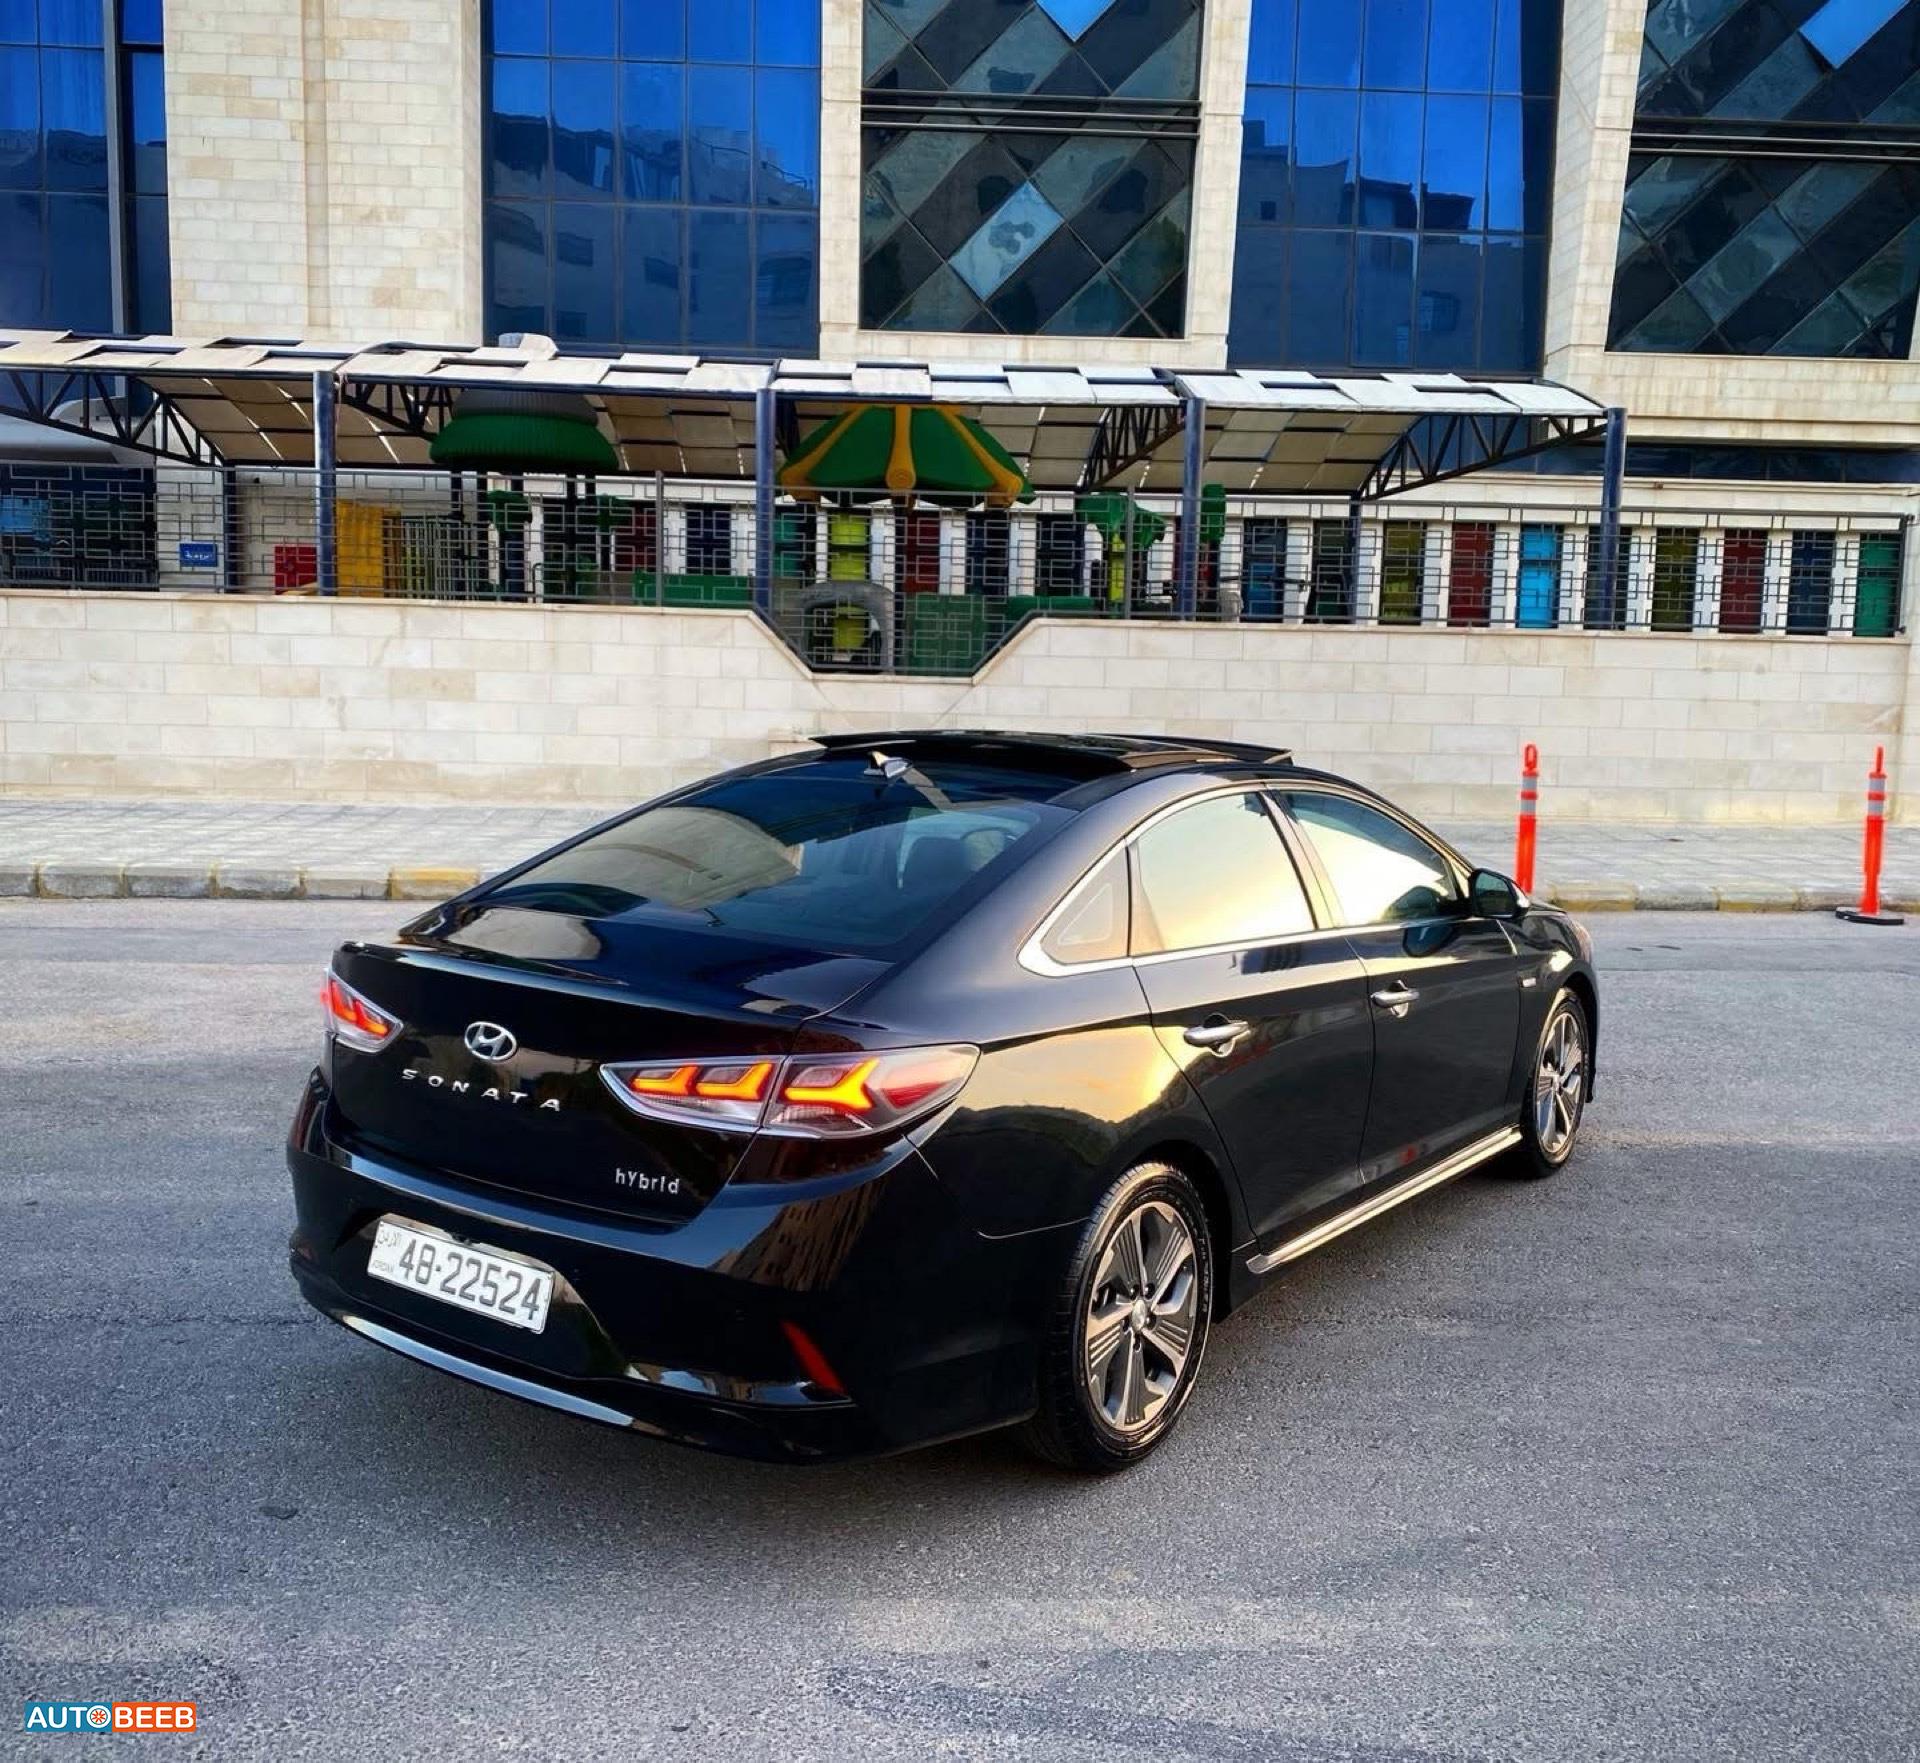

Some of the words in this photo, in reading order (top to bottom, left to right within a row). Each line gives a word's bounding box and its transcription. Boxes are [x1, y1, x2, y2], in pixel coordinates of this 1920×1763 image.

[402, 1069, 560, 1111] SONATA
[615, 1168, 680, 1194] hybrid
[399, 1239, 541, 1320] 48-22524
